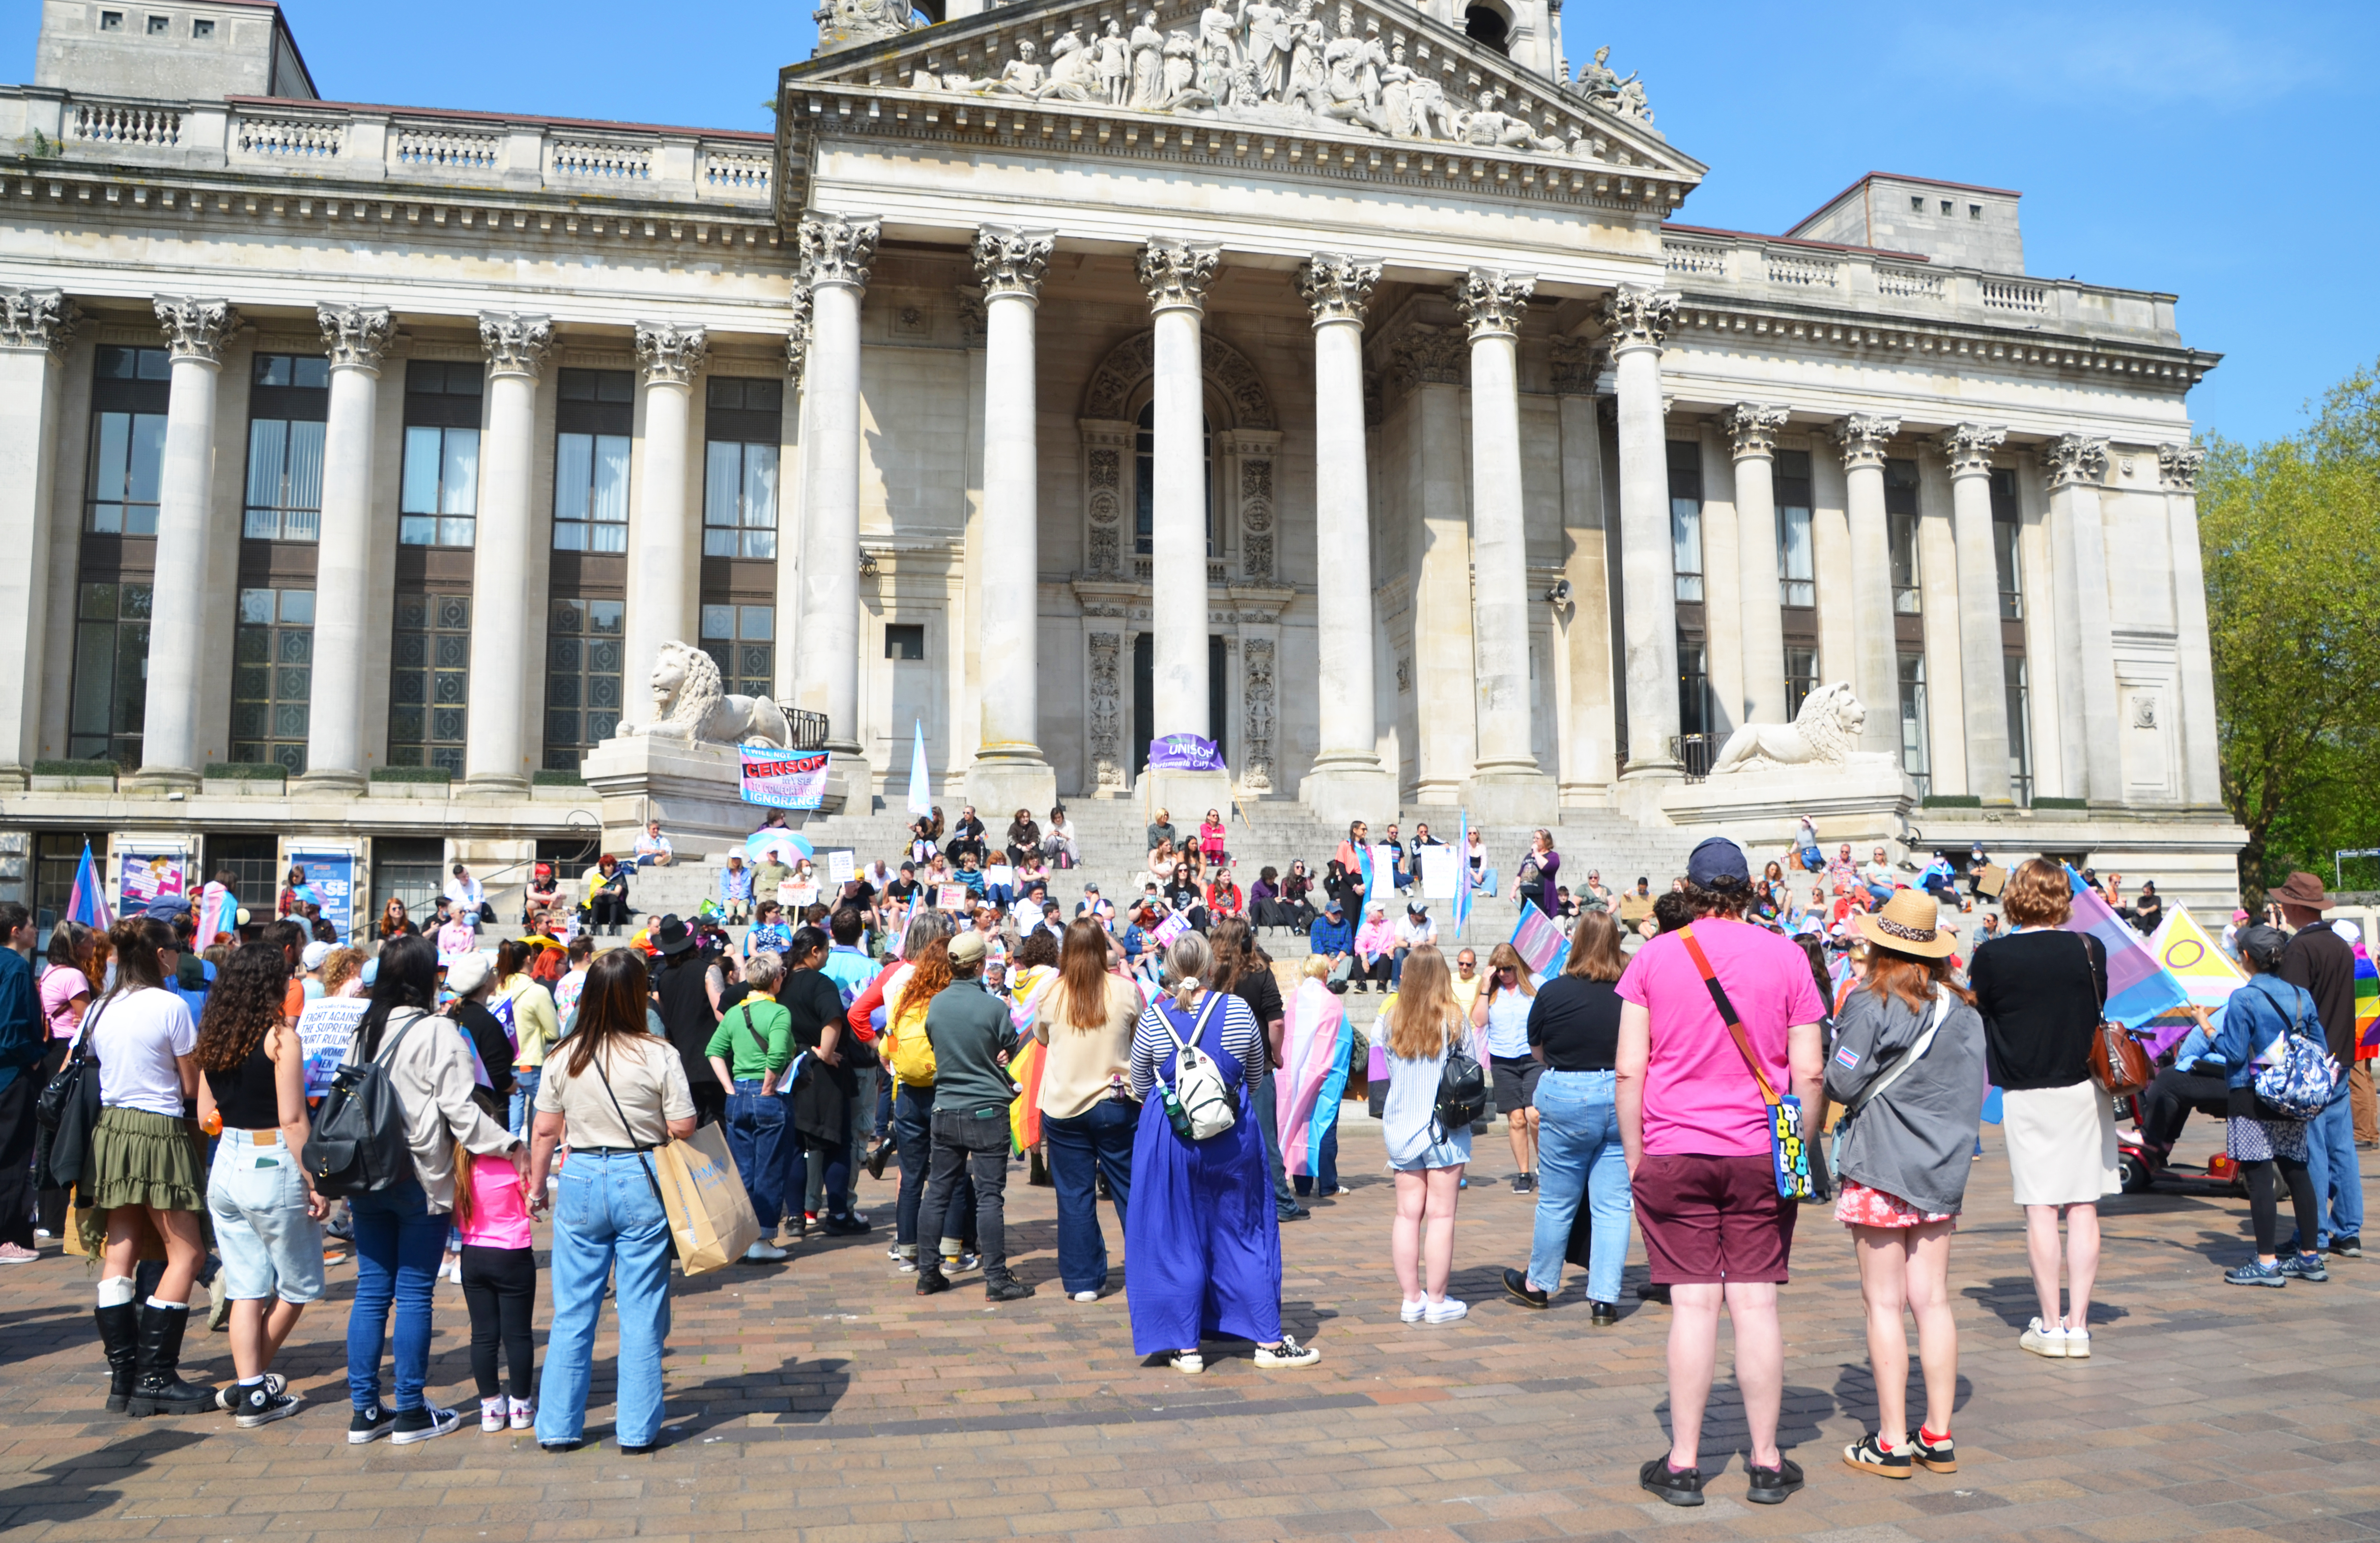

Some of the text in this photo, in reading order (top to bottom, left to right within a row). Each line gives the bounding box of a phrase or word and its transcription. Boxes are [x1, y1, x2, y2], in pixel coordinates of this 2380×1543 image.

[1169, 743, 1214, 758] UNISON
[746, 755, 825, 778] CENSOR
[1150, 758, 1191, 770] Portsmouth
[1193, 760, 1209, 770] City
[782, 776, 822, 785] MYSELF
[752, 782, 821, 796] TO COMFORT YOUR
[750, 792, 822, 806] IGNORANCE
[305, 1011, 362, 1023] FIGHT AGAINS
[301, 1023, 356, 1034] THE SUPREME
[322, 1034, 351, 1045] RULING
[303, 1047, 346, 1057] RANS WOME
